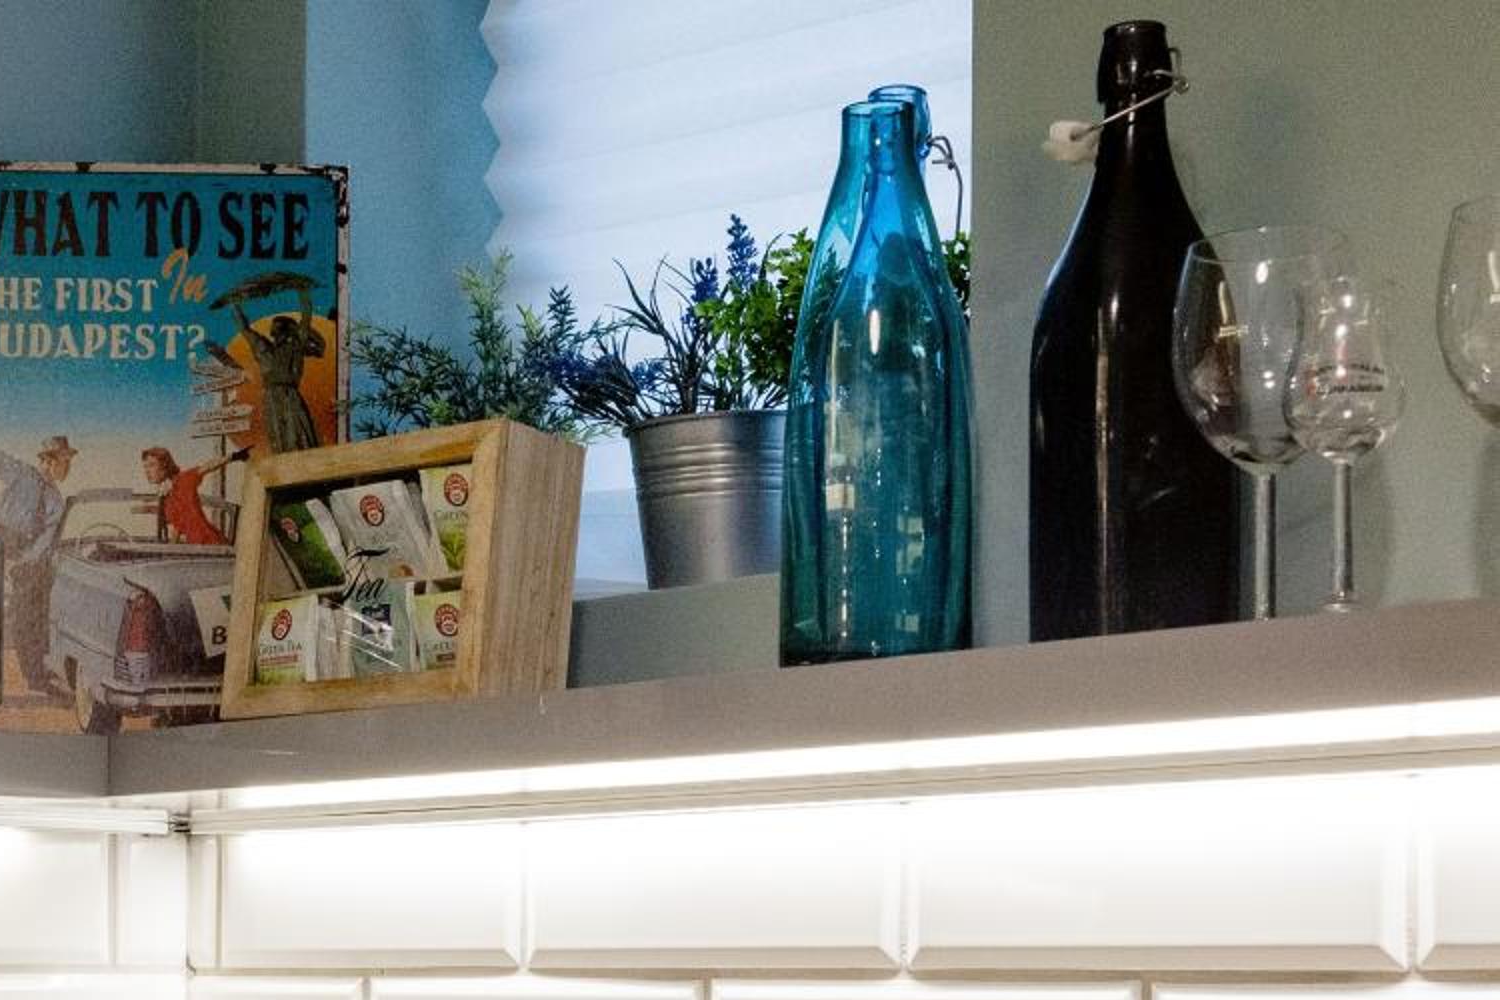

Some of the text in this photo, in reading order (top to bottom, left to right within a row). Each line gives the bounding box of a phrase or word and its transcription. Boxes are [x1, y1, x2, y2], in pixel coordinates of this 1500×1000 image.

[135, 191, 202, 258] TO
[217, 191, 310, 260] SEE
[54, 277, 158, 313] FIRST
[161, 246, 209, 305] In
[338, 547, 390, 605] Tea
